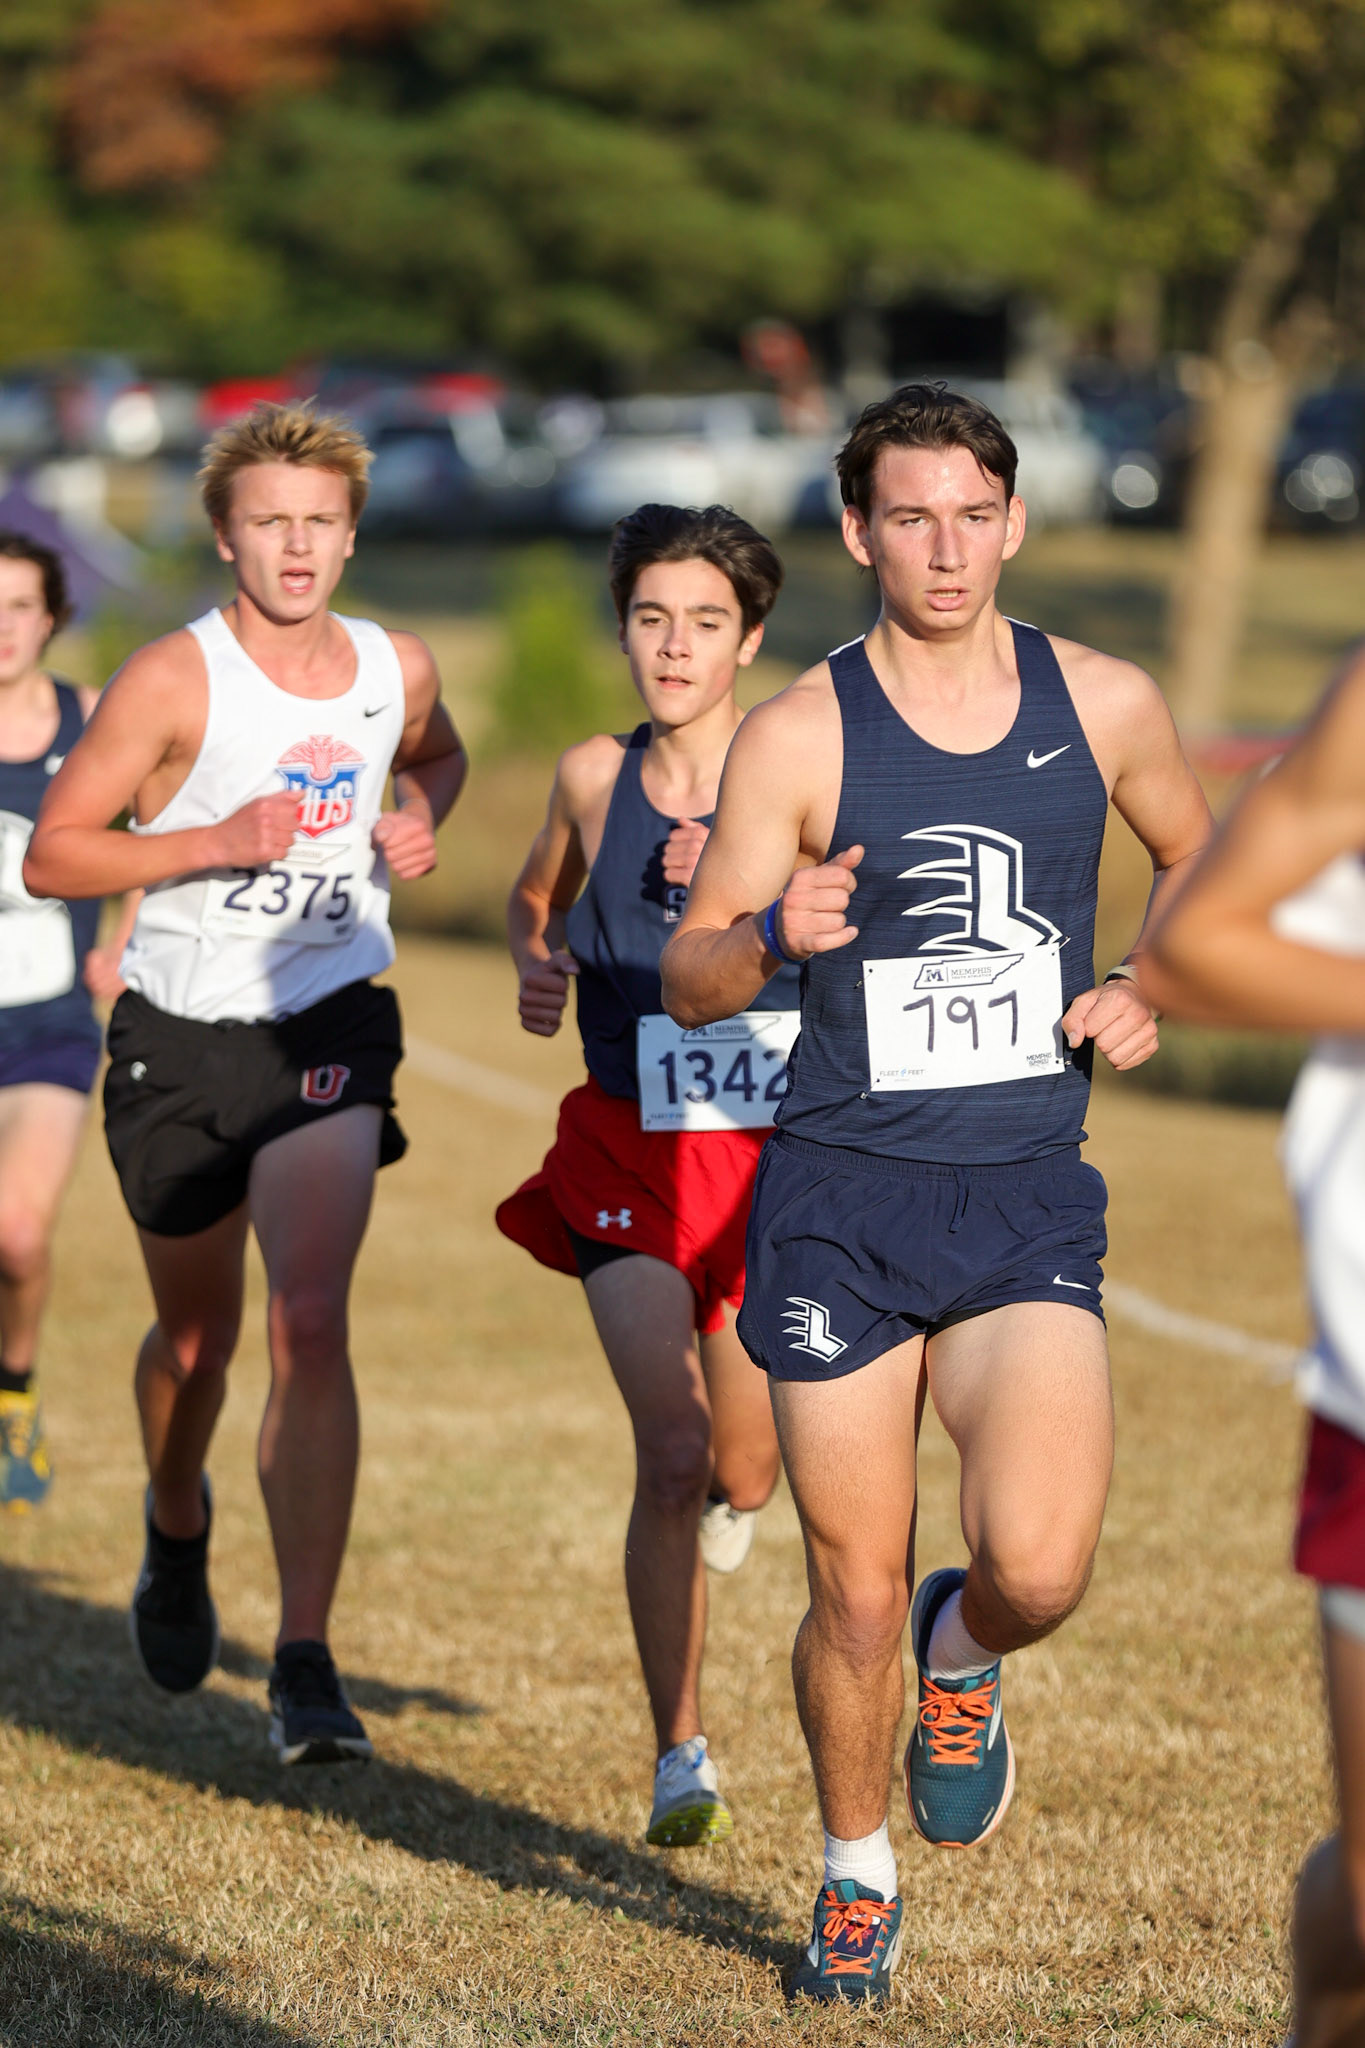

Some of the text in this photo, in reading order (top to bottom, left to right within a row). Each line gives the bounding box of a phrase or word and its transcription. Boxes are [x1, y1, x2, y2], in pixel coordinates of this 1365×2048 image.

[224, 867, 353, 921] 2375
[951, 966, 992, 976] MEMPHIS
[903, 989, 1018, 1053] 797
[659, 1049, 788, 1104] 1342
[908, 1068, 925, 1076] FEET
